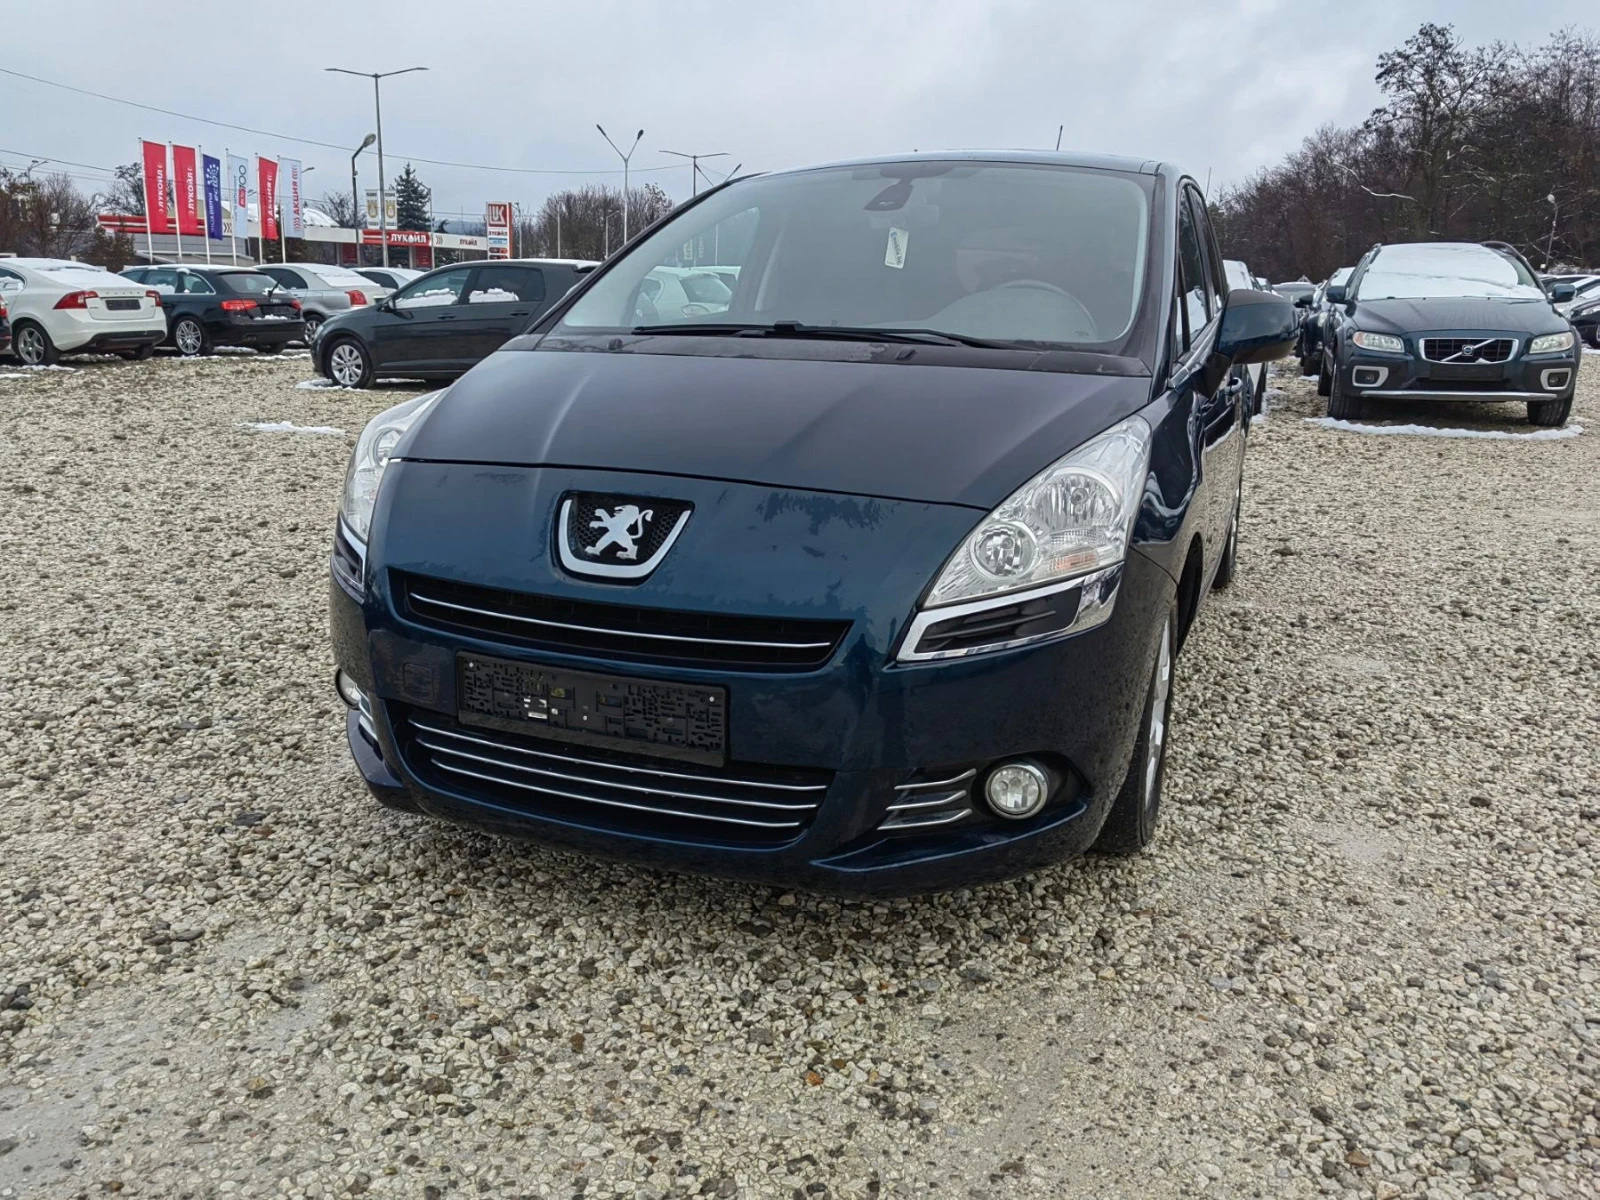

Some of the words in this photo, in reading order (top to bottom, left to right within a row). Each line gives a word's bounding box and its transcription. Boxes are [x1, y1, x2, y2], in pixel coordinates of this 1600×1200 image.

[186, 172, 195, 210] ЛУКОЙЛ
[291, 181, 299, 216] АКЦИЯ
[390, 231, 427, 244] ЛУКОЙЛ
